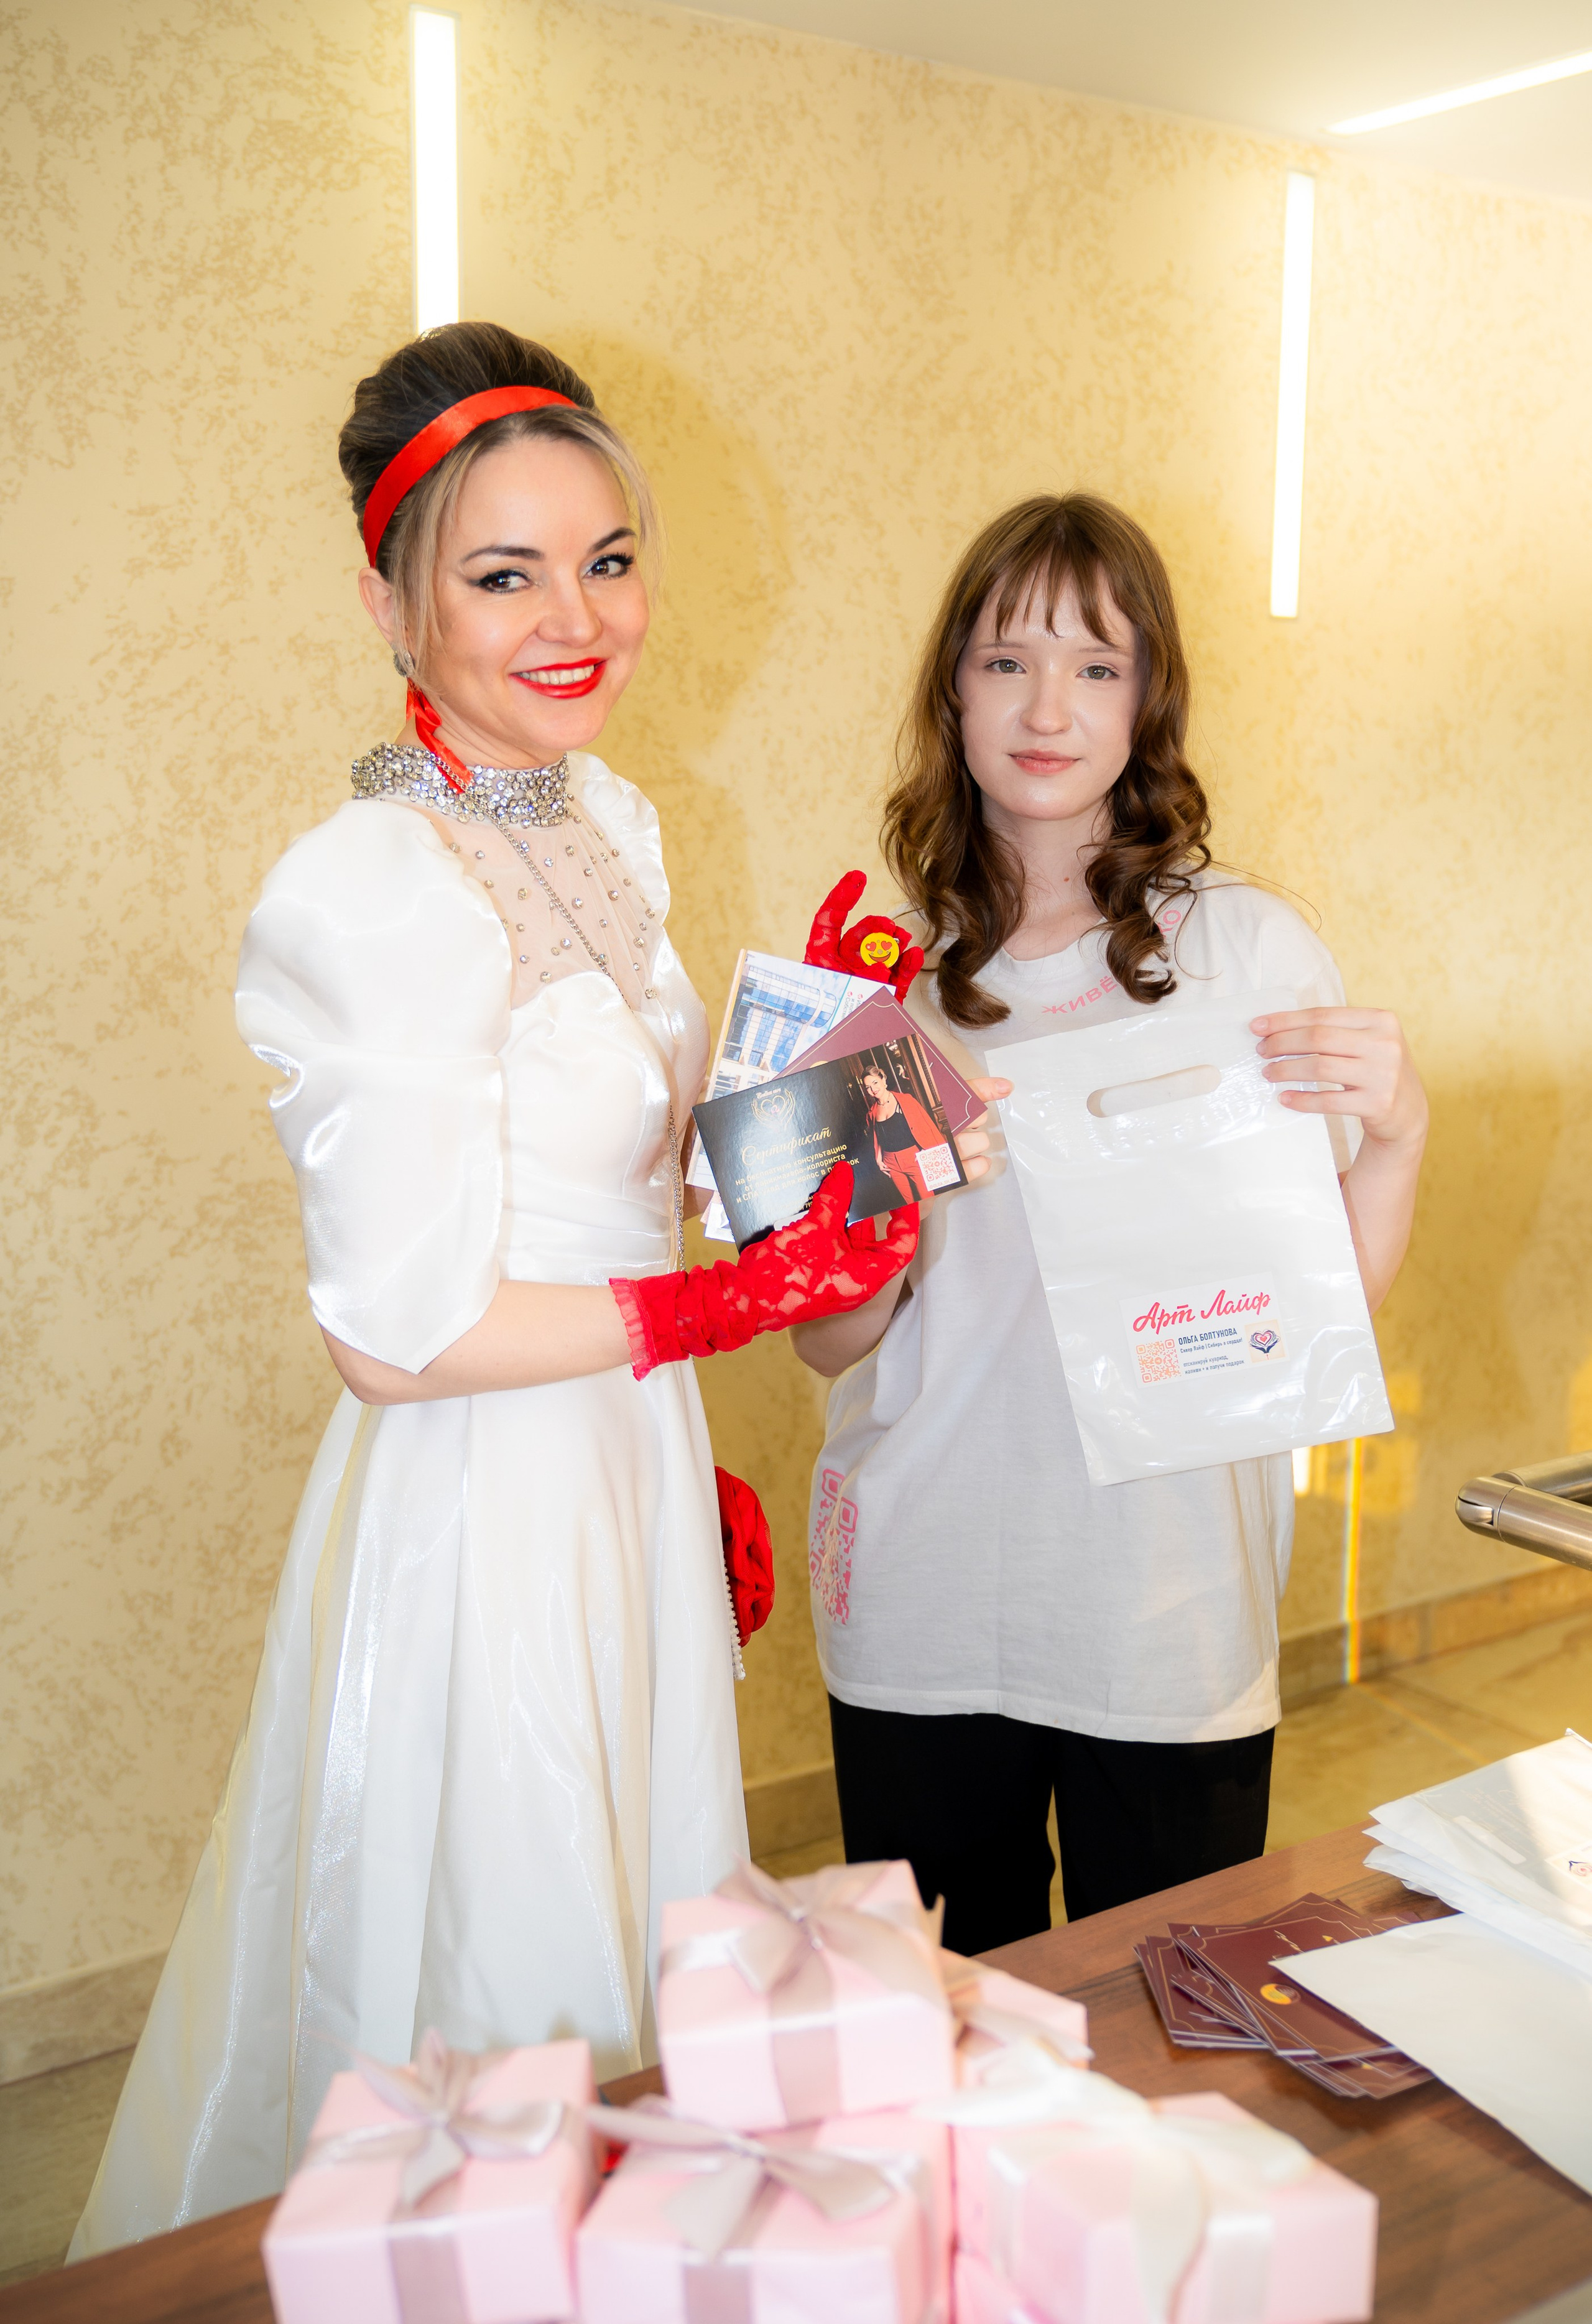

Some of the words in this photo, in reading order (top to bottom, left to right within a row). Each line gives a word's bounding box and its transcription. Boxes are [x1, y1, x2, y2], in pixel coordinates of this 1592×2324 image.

[1042, 975, 1118, 1014] ЖИВЁ
[742, 1127, 831, 1165] Сертификат
[747, 1164, 792, 1182] бесплатную
[794, 1144, 847, 1167] консультацию
[797, 1172, 819, 1183] волос
[1132, 1302, 1195, 1335] Арт
[1201, 1289, 1270, 1319] Лайф
[1178, 1335, 1198, 1345] ОЛЬГА
[1200, 1328, 1238, 1341] БОЛТУНОВА
